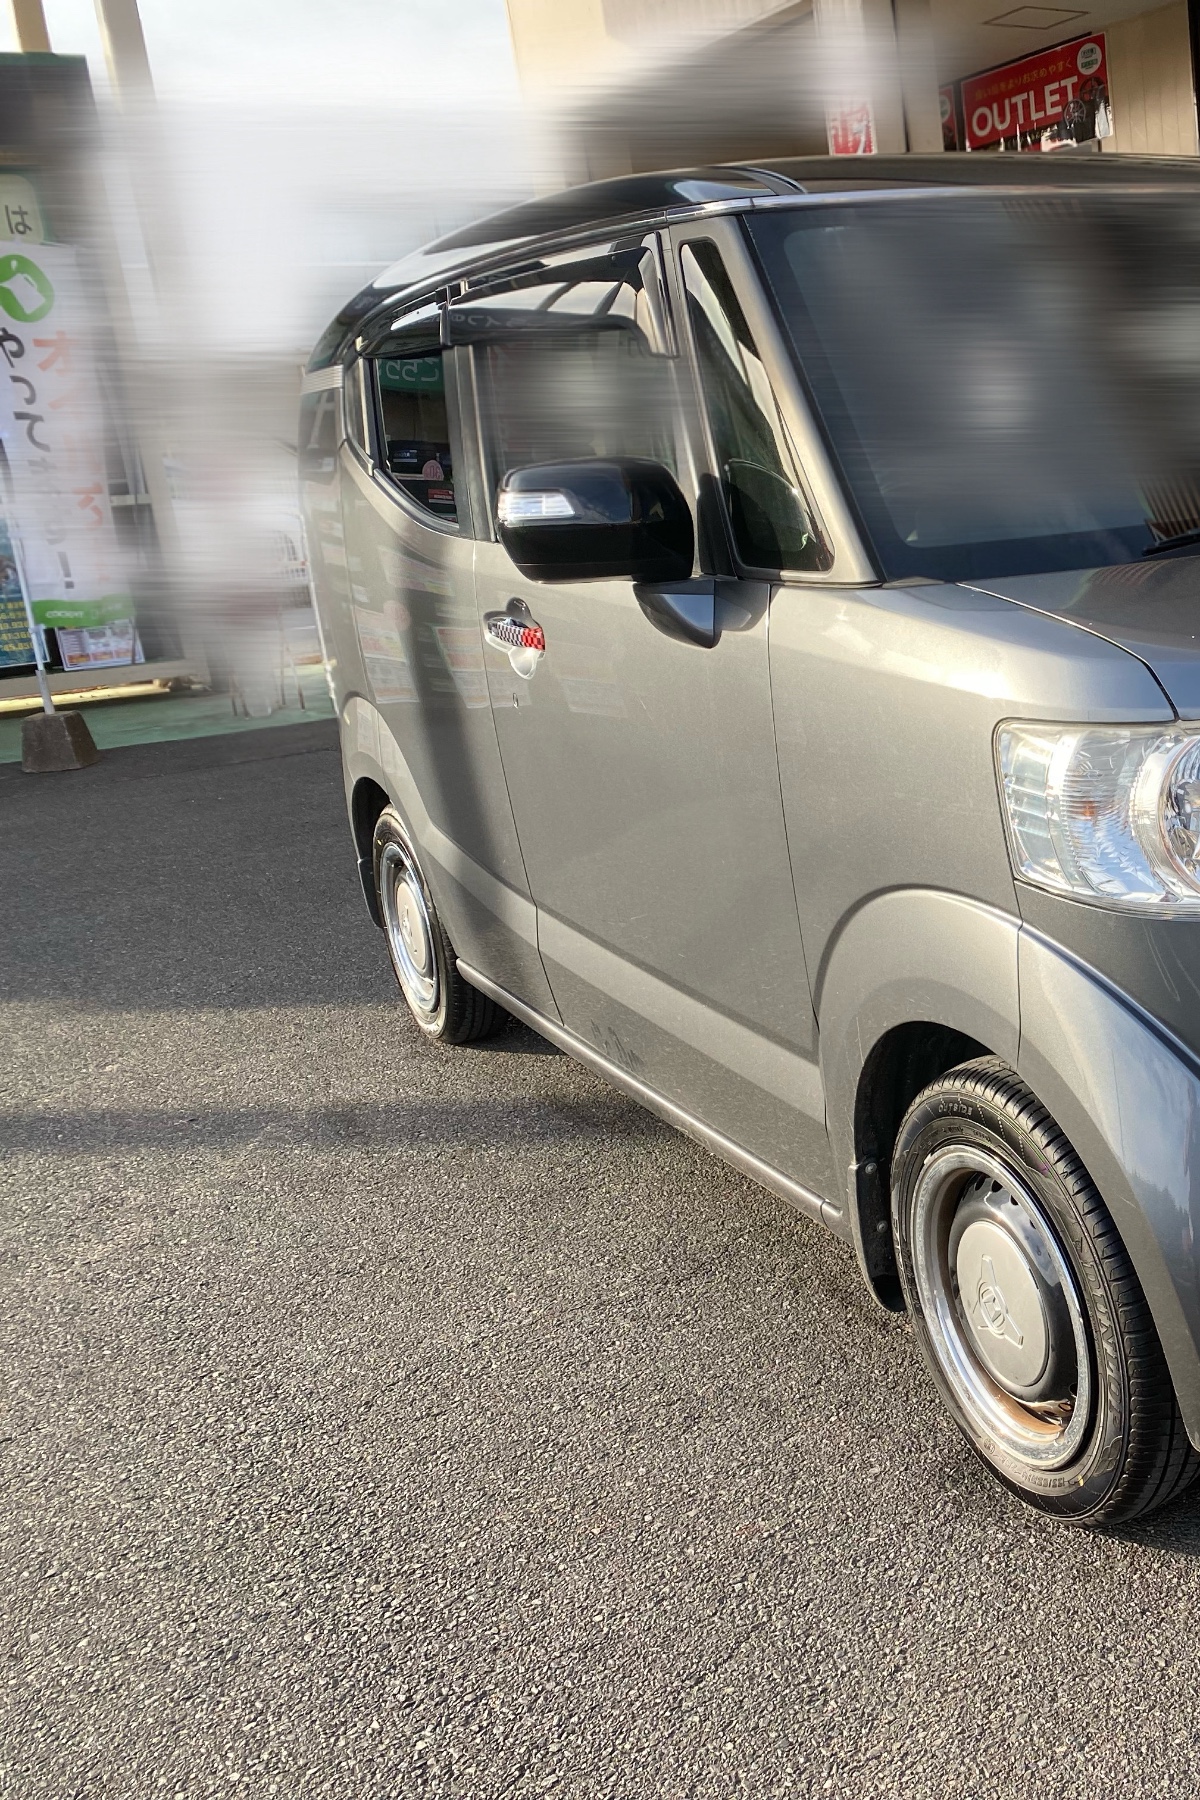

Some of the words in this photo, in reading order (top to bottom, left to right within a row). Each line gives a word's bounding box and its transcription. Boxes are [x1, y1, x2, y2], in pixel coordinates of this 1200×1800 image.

[972, 75, 1078, 138] OUTLET
[938, 1102, 973, 1116] OUTSIDE
[1080, 1260, 1122, 1428] DUNLOP
